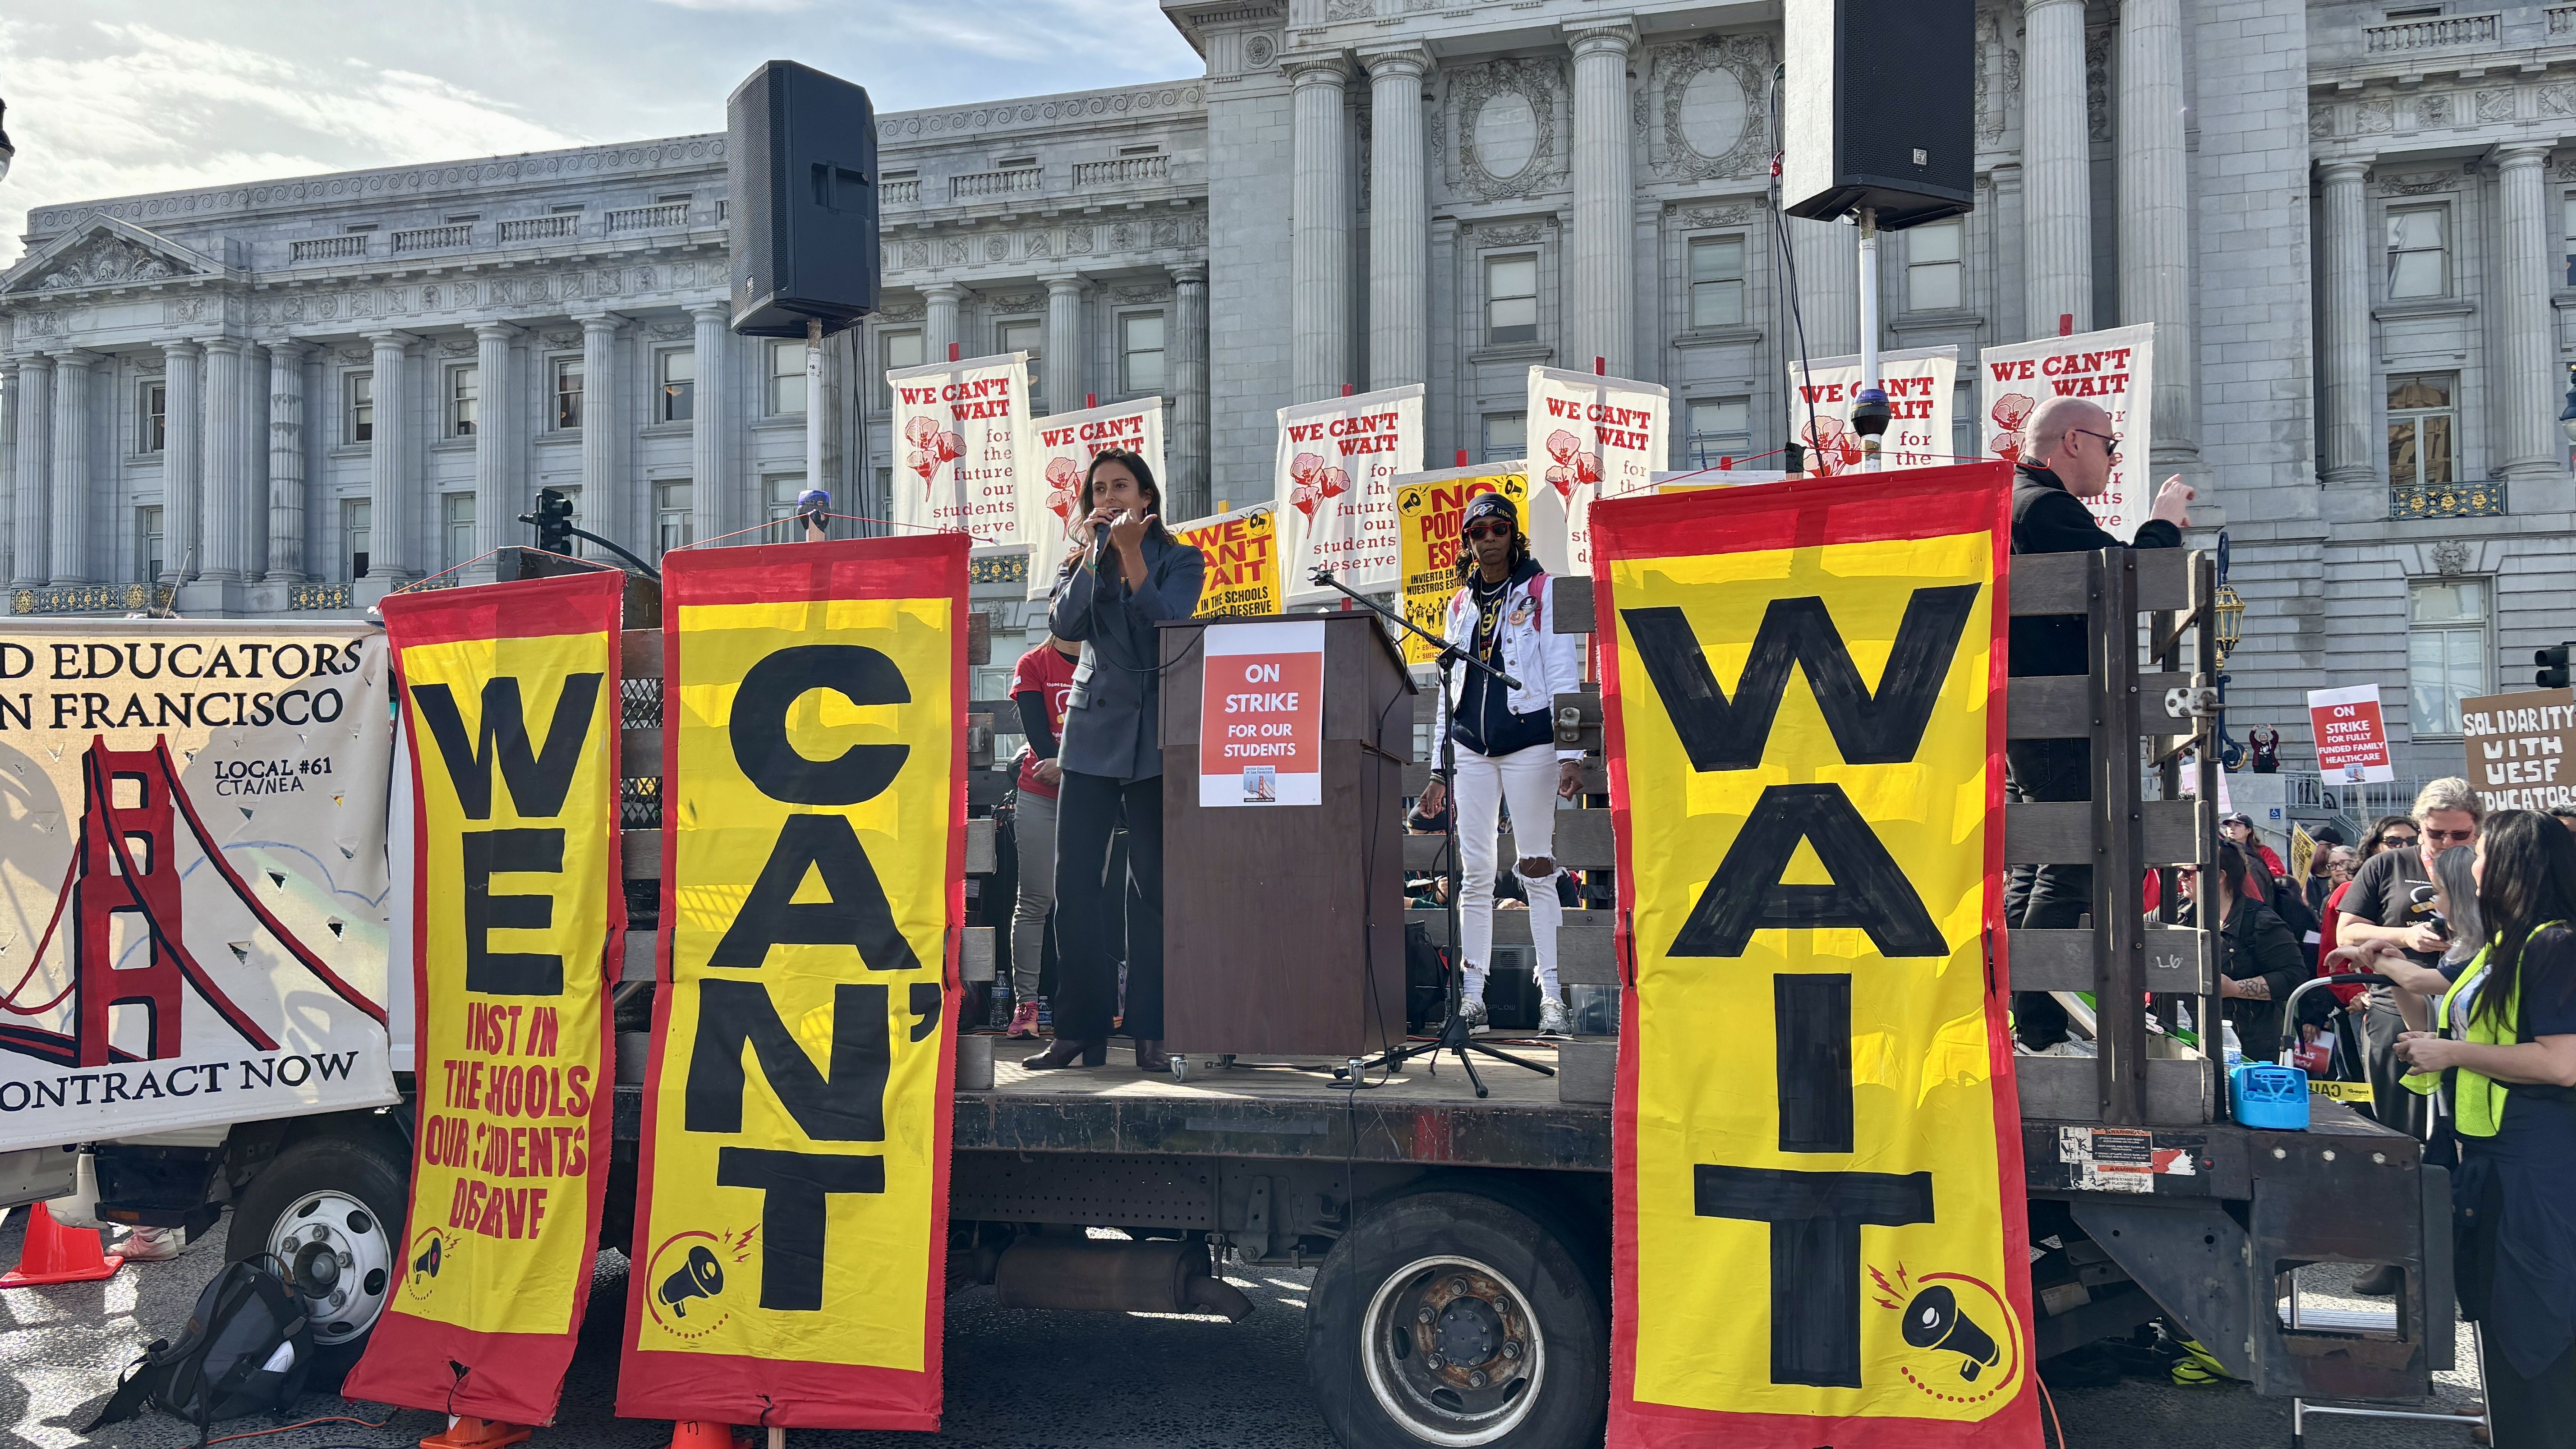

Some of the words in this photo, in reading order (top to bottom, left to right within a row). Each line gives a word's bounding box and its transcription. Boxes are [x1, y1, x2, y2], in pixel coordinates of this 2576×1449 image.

[1991, 359, 2035, 382] WE
[2042, 348, 2130, 376] CAN'T
[900, 387, 936, 405] WE
[942, 378, 1009, 401] CAN'T
[1799, 384, 1843, 404] WE
[2052, 373, 2129, 397] WAIT
[951, 399, 1009, 421] WAIT
[1546, 397, 1580, 420] WE
[1587, 404, 1650, 429] CAN'T
[1891, 400, 1933, 419] AIT
[987, 429, 1011, 442] for
[1041, 427, 1075, 447] WE
[1080, 415, 1143, 441] CAN'T
[1288, 423, 1323, 443] WE
[1329, 412, 1398, 437] CAN'T
[1338, 434, 1398, 456] WAIT
[1595, 426, 1648, 451] WAIT
[1900, 431, 1932, 446] for
[984, 447, 1012, 461] the
[1896, 451, 1932, 465] the
[955, 467, 1012, 481] future
[1371, 464, 1397, 477] for
[1623, 460, 1646, 476] for
[983, 485, 1013, 496] our
[1431, 483, 1496, 512] NO
[934, 501, 1014, 518] students
[1338, 502, 1393, 516] future
[938, 521, 1014, 535] deserve
[1186, 519, 1247, 549] WE
[1364, 520, 1395, 530] our
[1204, 534, 1272, 568] AN'T
[1314, 536, 1396, 554] students
[1319, 556, 1396, 573] deserve
[1203, 559, 1266, 591] AIT
[1411, 571, 1443, 584] INVIERTA
[1445, 569, 1454, 579] EN
[1407, 582, 1444, 595] NUESTROS
[1201, 598, 1209, 612] IN
[1211, 593, 1222, 607] THE
[1225, 586, 1268, 603] SCHOOLS
[1230, 600, 1272, 616] DESERVE
[50, 639, 363, 679] EDUCATORS
[1245, 664, 1280, 683] ON
[49, 688, 343, 729] FRANCISCO
[1225, 692, 1299, 713] STRIKE
[2333, 705, 2355, 718] ON
[2326, 720, 2370, 734] STRIKE
[2463, 704, 2575, 736] SOLIDARITY
[1228, 724, 1257, 737] FOR
[1261, 724, 1293, 736] OUR
[2327, 735, 2345, 743] FOR
[2346, 732, 2371, 741] FULLY
[1224, 743, 1296, 757] STUDENTS
[2318, 745, 2351, 754] FUNDED
[2353, 741, 2384, 751] FAMILY
[2483, 736, 2563, 759] WITH
[214, 759, 293, 779] LOCAL
[299, 757, 332, 775] #61
[2325, 753, 2381, 764] HEALTHCARE
[2485, 758, 2560, 785] UESF
[216, 776, 304, 796] CTA/NEA
[409, 672, 604, 996] WE
[685, 644, 942, 1311] CAN'T
[1619, 582, 1983, 1389] WAIT
[525, 1006, 559, 1057] IN
[239, 1051, 359, 1089] NOW
[444, 1060, 484, 1109] THE
[425, 1114, 469, 1168] OUR
